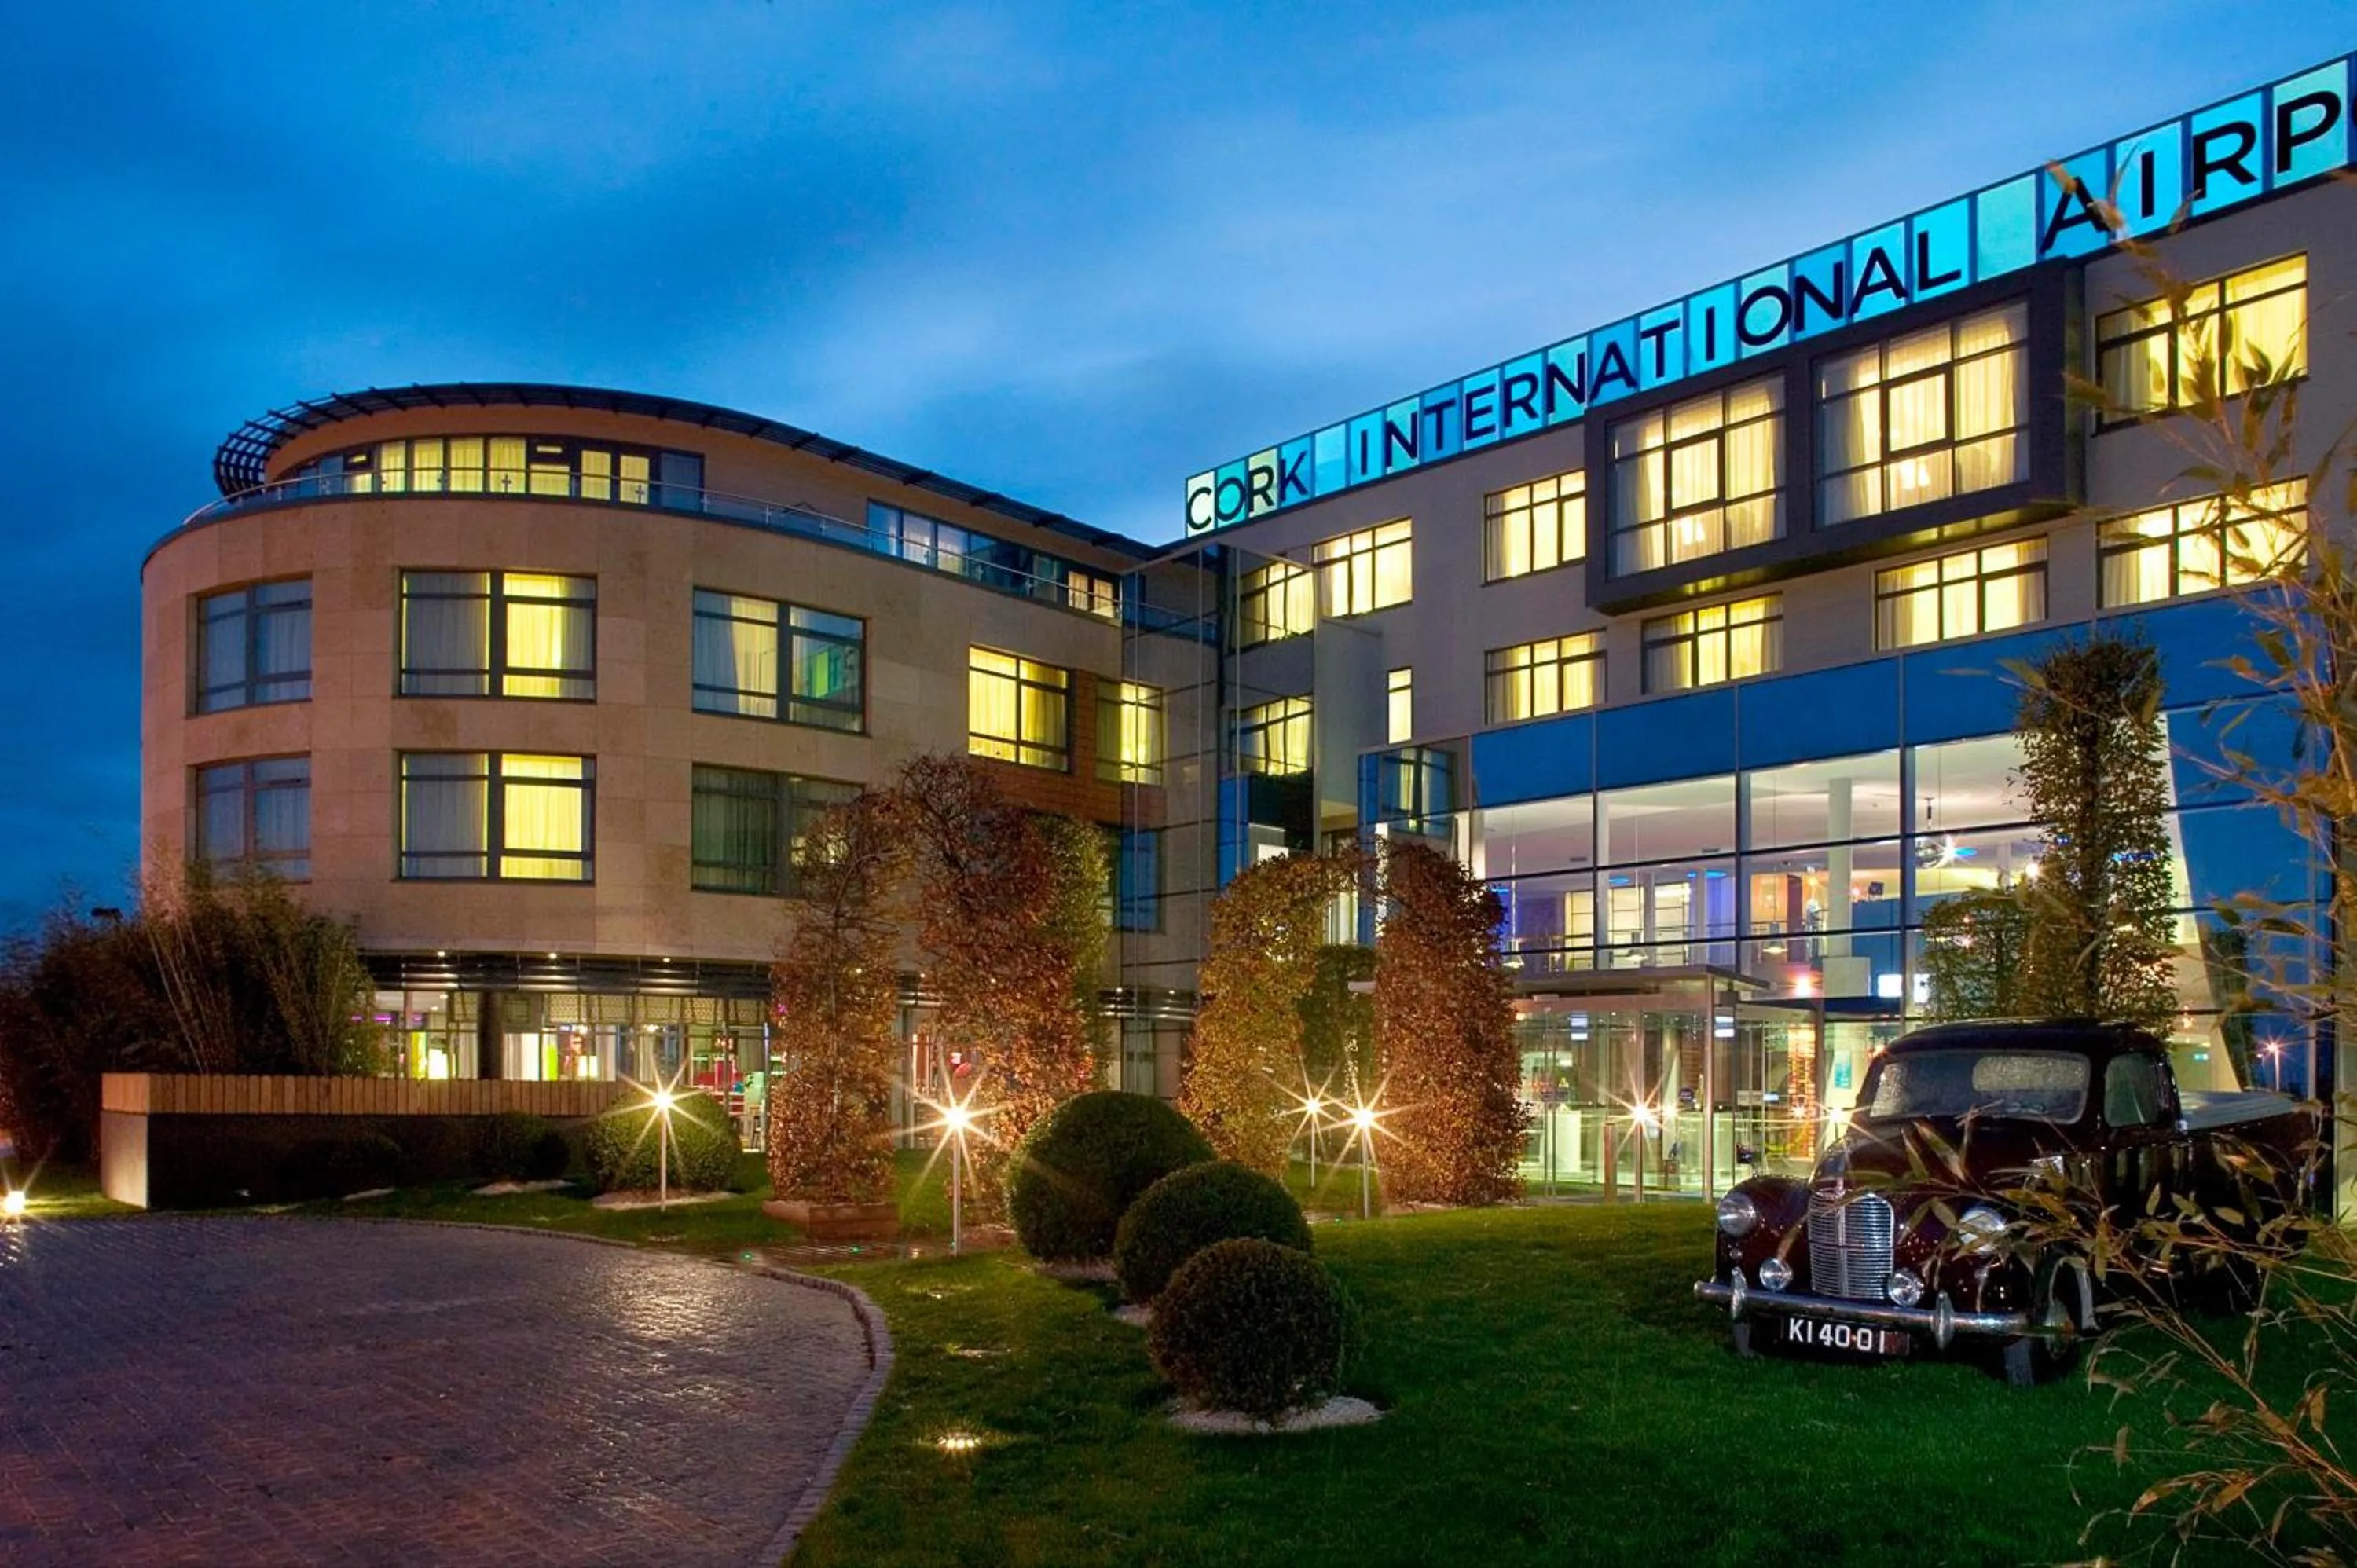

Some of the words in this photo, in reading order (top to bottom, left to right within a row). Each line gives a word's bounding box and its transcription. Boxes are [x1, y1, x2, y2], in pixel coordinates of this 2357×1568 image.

[1187, 451, 1309, 530] CORK
[1360, 230, 1962, 475] INTERNATIONAL
[2039, 90, 2357, 254] AIRP
